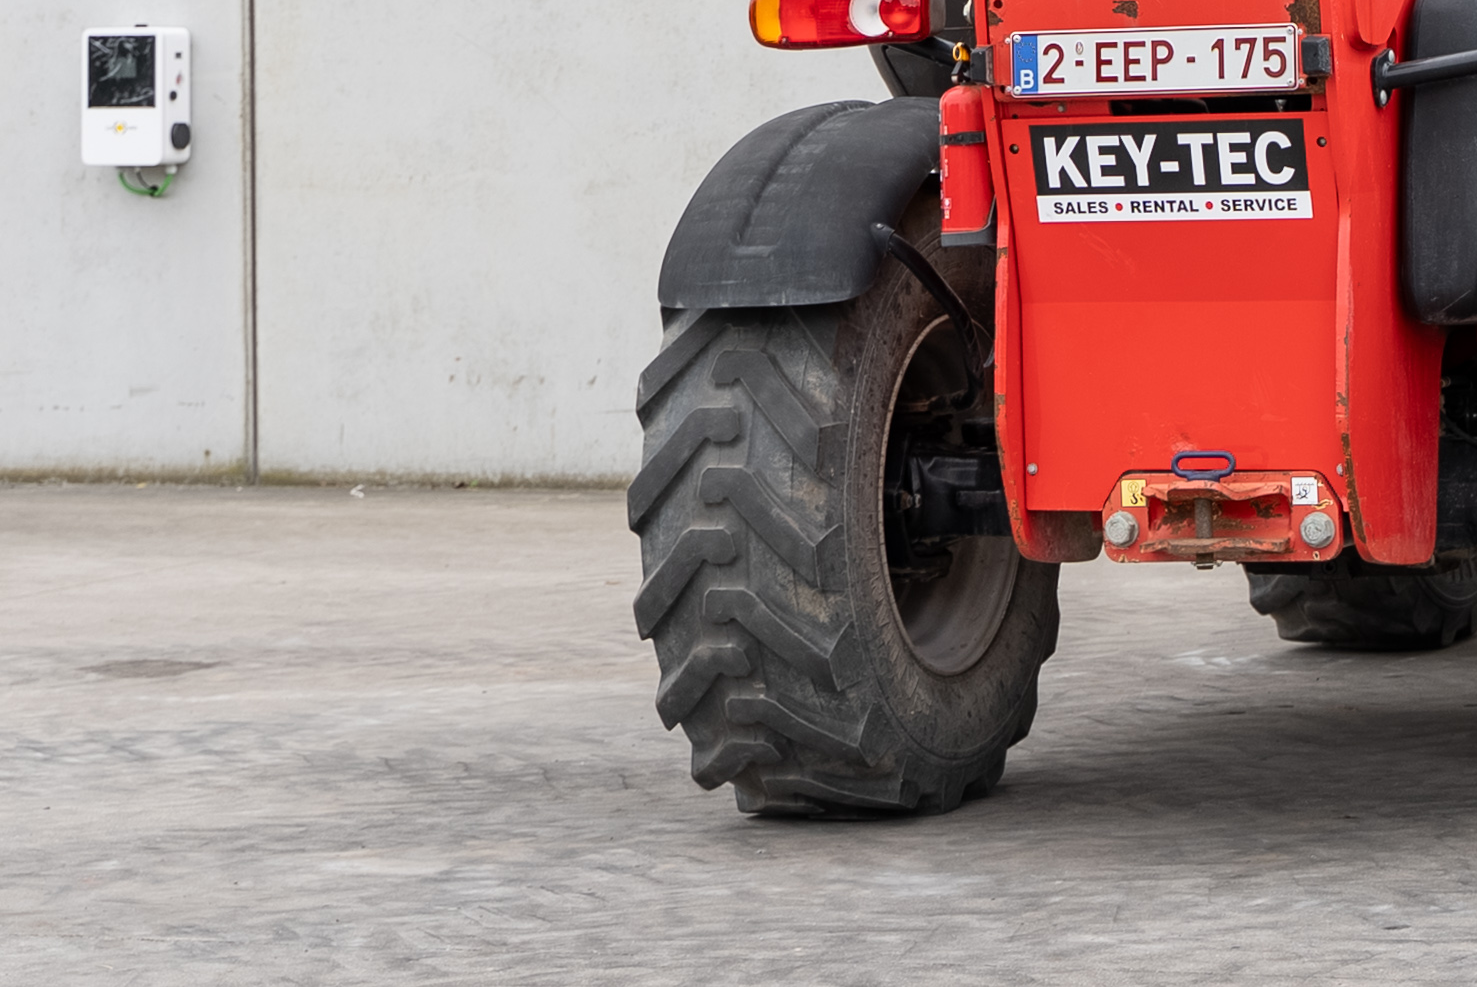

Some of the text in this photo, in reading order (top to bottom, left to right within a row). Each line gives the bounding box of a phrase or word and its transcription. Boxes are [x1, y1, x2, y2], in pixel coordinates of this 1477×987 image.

[1019, 69, 1034, 90] B
[1043, 131, 1296, 189] KEY-TEC
[1053, 197, 1298, 215] SALES RENTAL SERVICE
